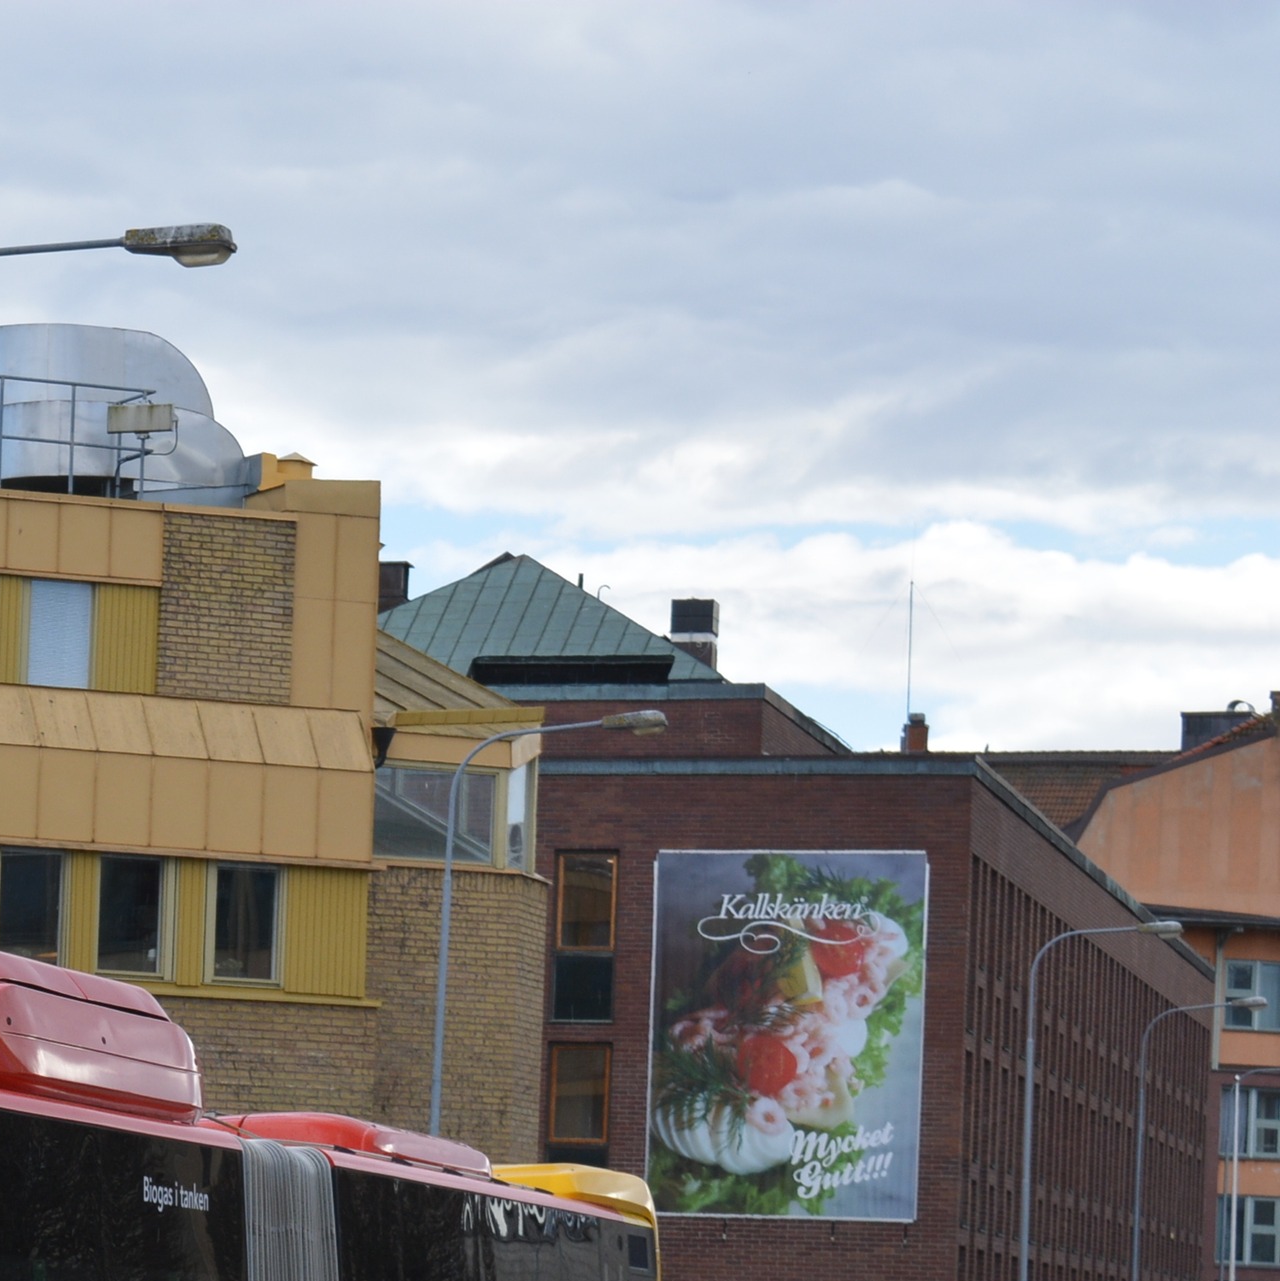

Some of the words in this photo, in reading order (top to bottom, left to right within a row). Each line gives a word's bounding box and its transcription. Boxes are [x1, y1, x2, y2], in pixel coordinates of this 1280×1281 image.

[718, 893, 862, 919] Kallskänken
[789, 1121, 895, 1168] Mycket
[143, 1175, 174, 1213] Biogas
[174, 1181, 179, 1207] i
[180, 1182, 209, 1212] tanken
[793, 1151, 894, 1199] Gutt!!!
